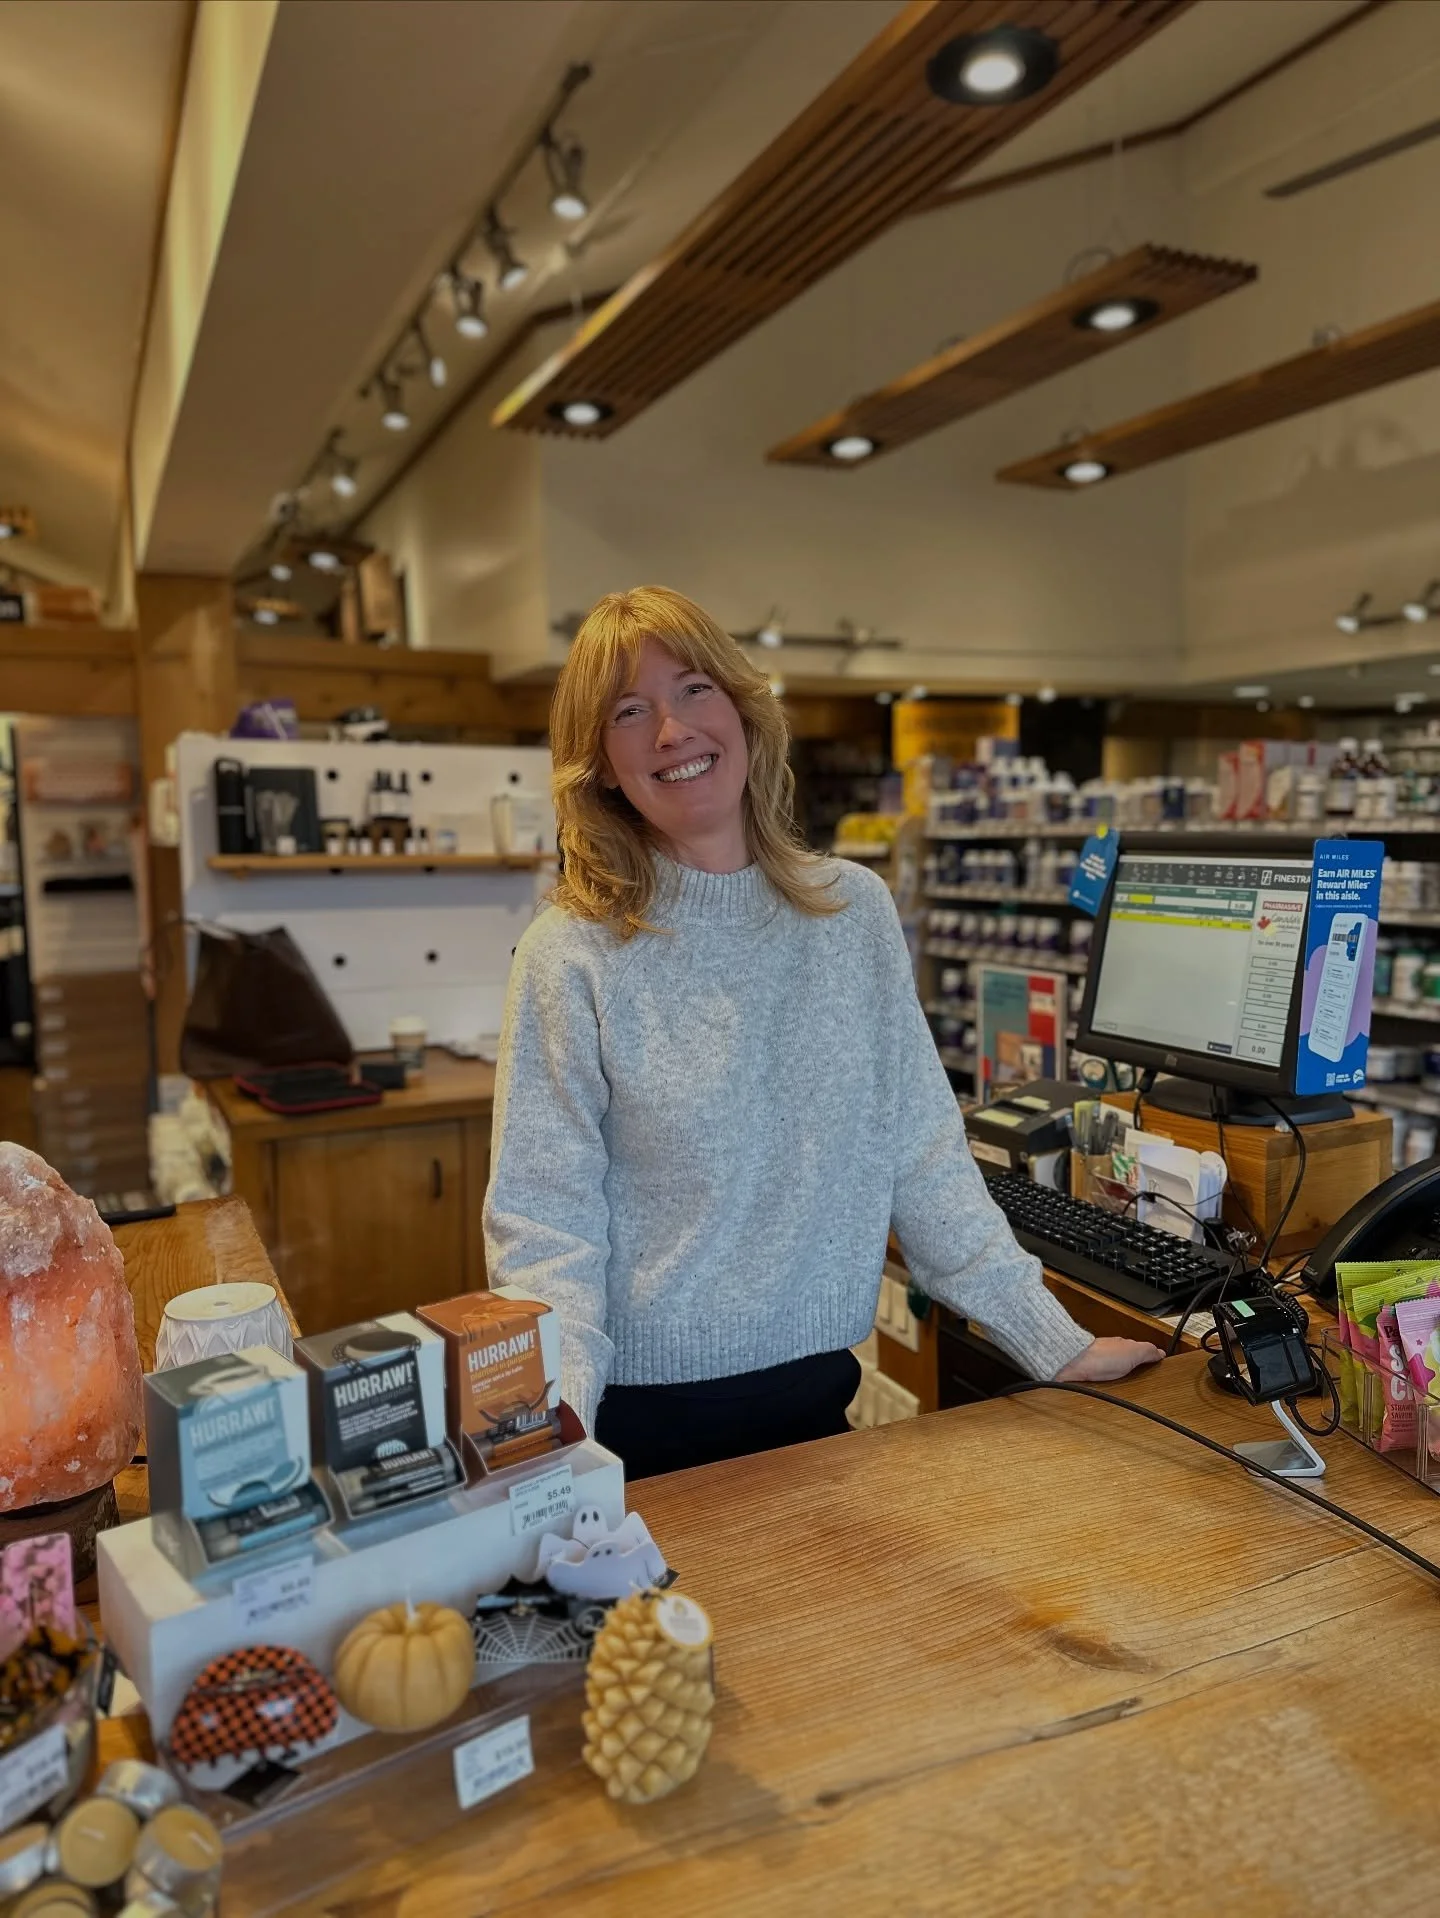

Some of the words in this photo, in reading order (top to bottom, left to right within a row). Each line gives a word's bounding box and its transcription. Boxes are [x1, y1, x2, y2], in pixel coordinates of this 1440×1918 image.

[1318, 868, 1336, 878] Earn
[1336, 868, 1350, 878] AIR
[1317, 880, 1346, 889] Reward
[1347, 880, 1369, 889] Miles
[1315, 890, 1323, 900] in
[1325, 890, 1340, 900] this
[1341, 891, 1361, 901] aisle.
[1252, 1045, 1266, 1054] 0.00
[468, 1330, 536, 1373] HURRAW!
[334, 1361, 414, 1408] HURRAW!
[189, 1400, 276, 1448] HURRAW!
[547, 1485, 571, 1500] $5.49
